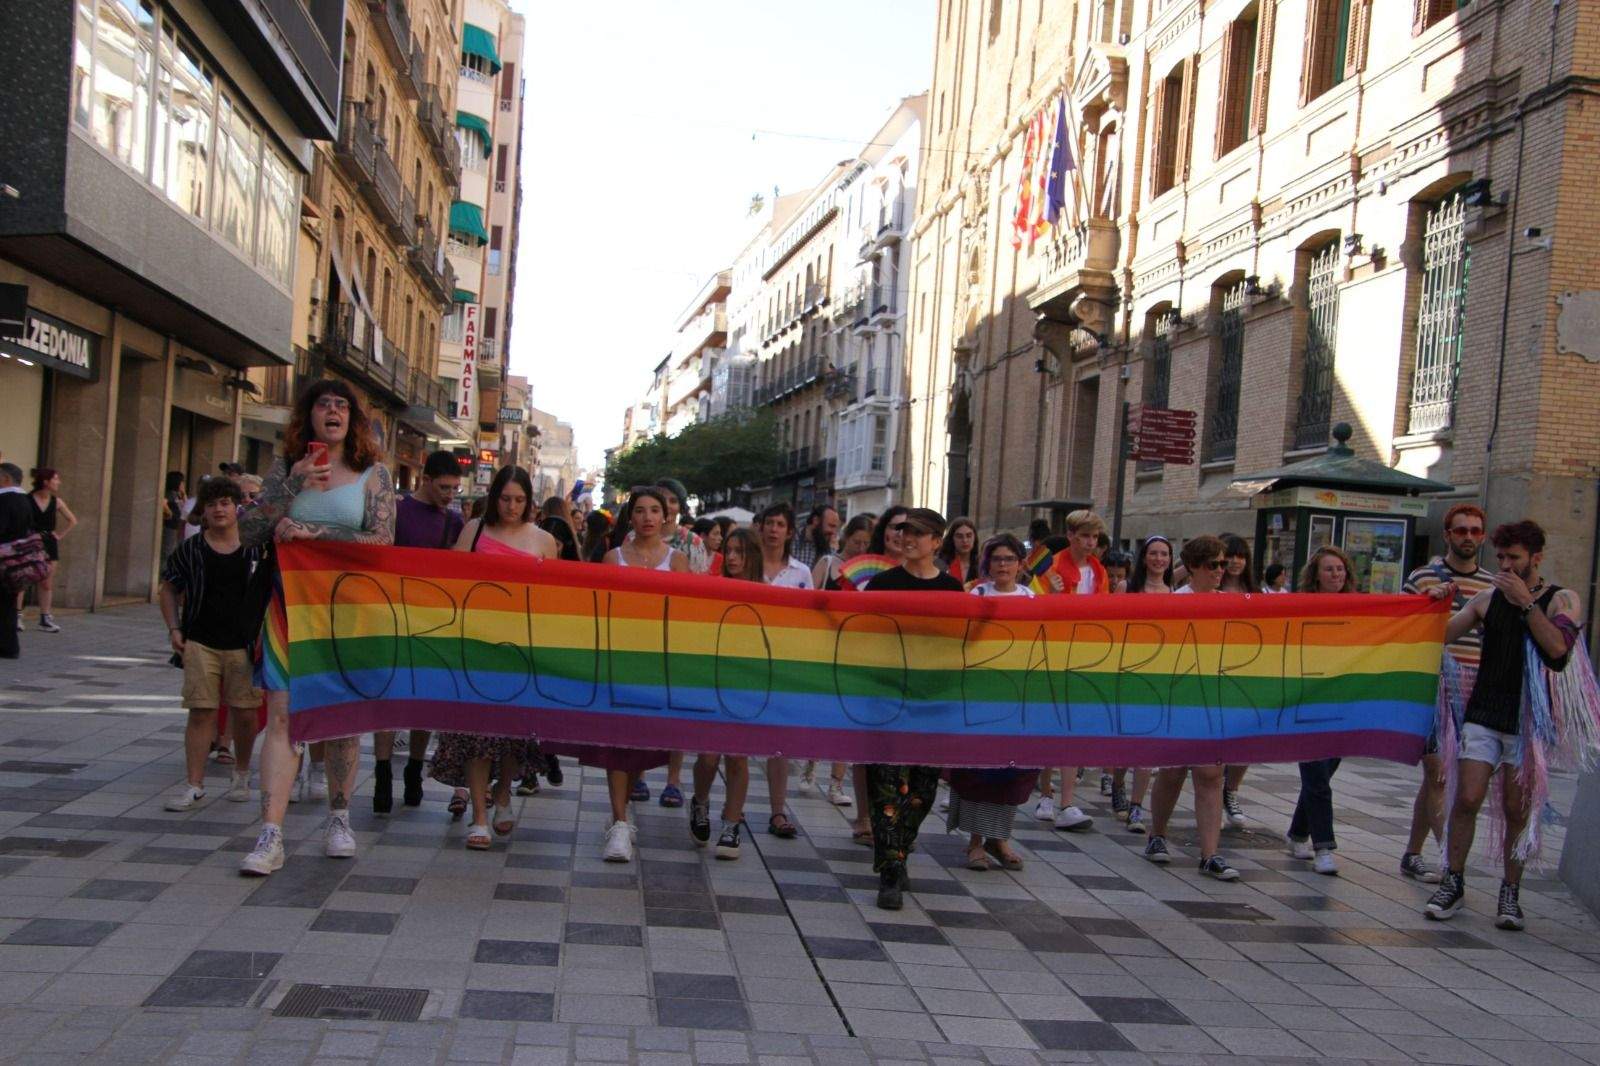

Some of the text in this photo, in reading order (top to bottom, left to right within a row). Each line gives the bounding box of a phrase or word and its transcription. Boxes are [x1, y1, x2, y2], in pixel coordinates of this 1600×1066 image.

[2, 316, 89, 368] LZEDONIA
[460, 306, 477, 418] FARMACIA
[330, 572, 1351, 736] ORGULLO O BARBARIE
